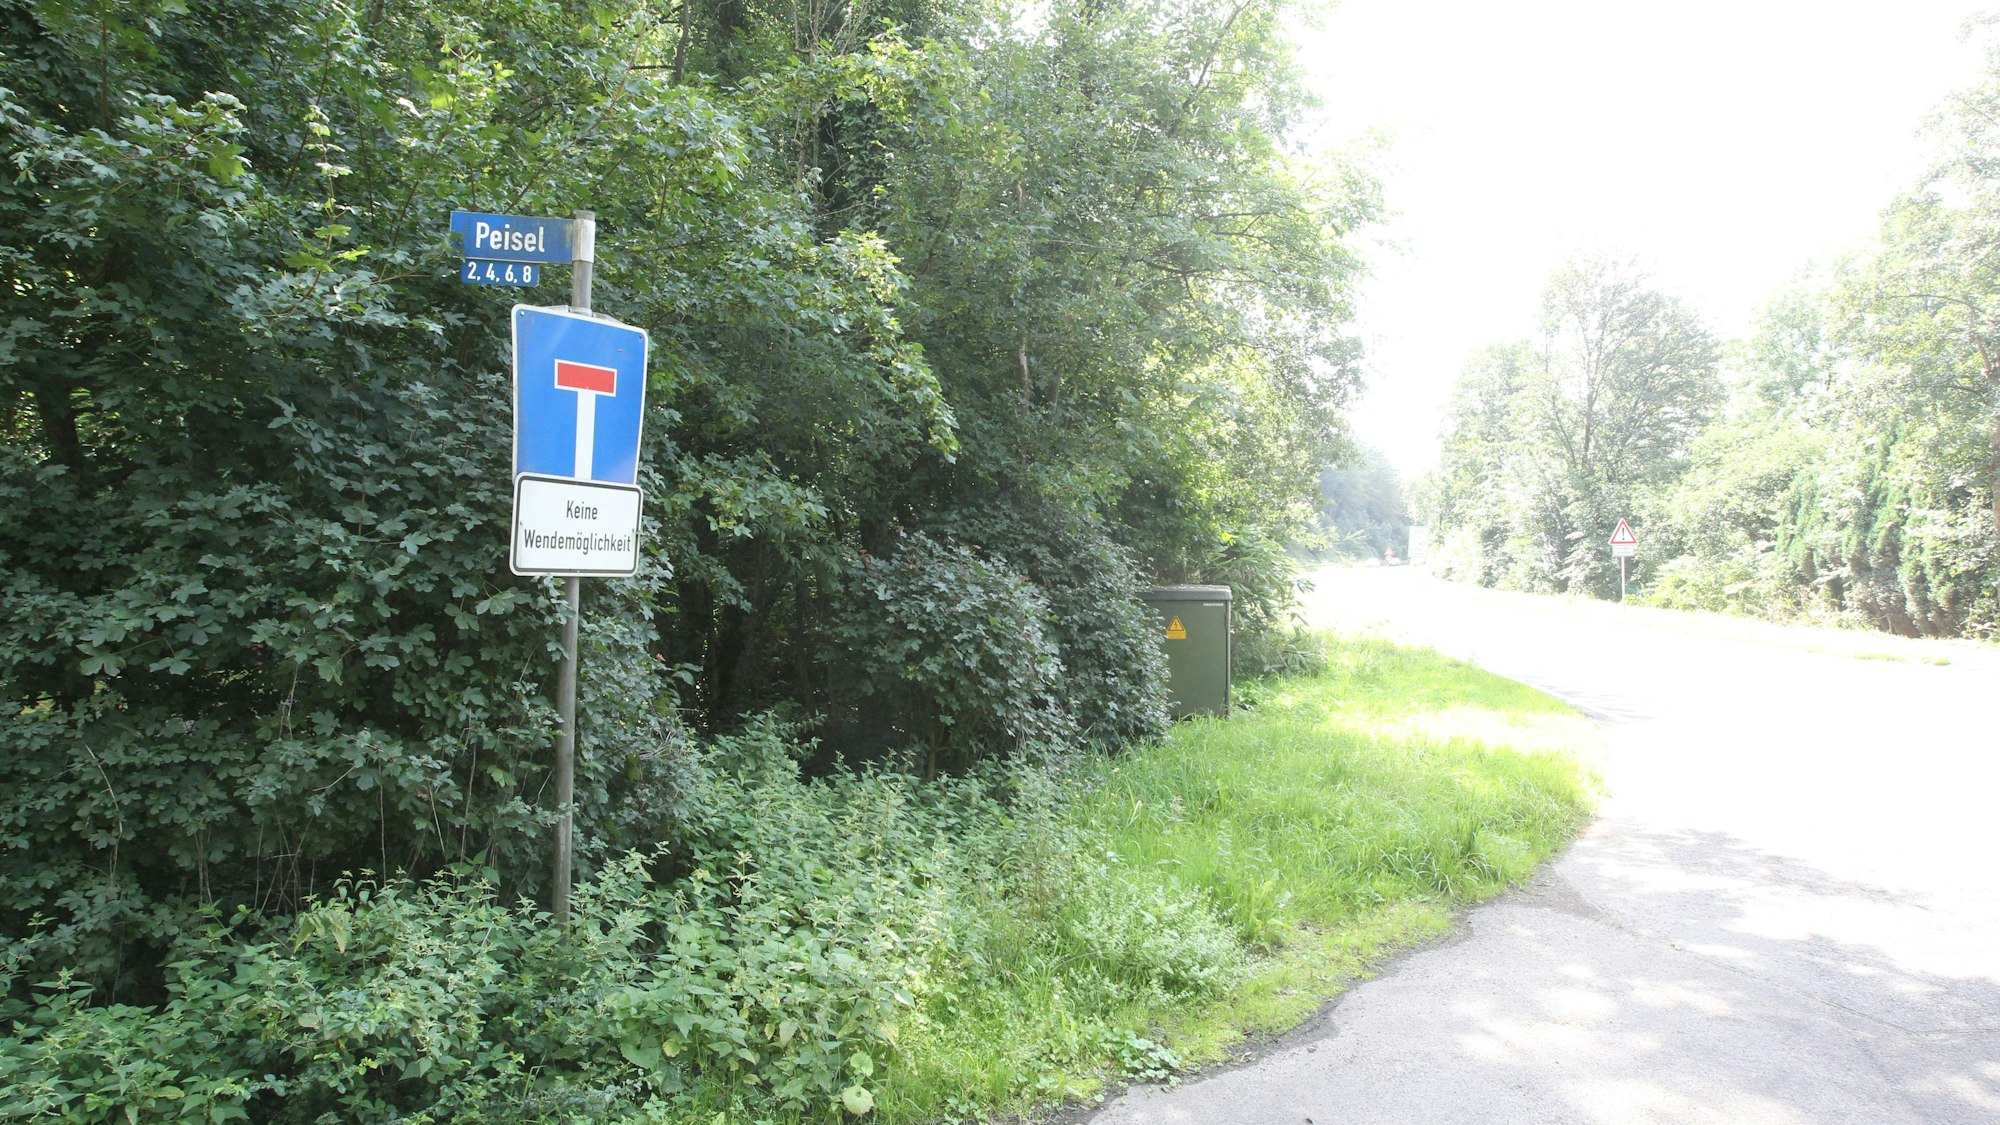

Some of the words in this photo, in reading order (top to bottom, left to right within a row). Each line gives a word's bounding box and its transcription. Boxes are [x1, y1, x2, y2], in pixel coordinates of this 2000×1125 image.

[475, 221, 545, 253] Peisel
[566, 500, 598, 520] Keine
[524, 529, 631, 555] Wendemöglichkeit
